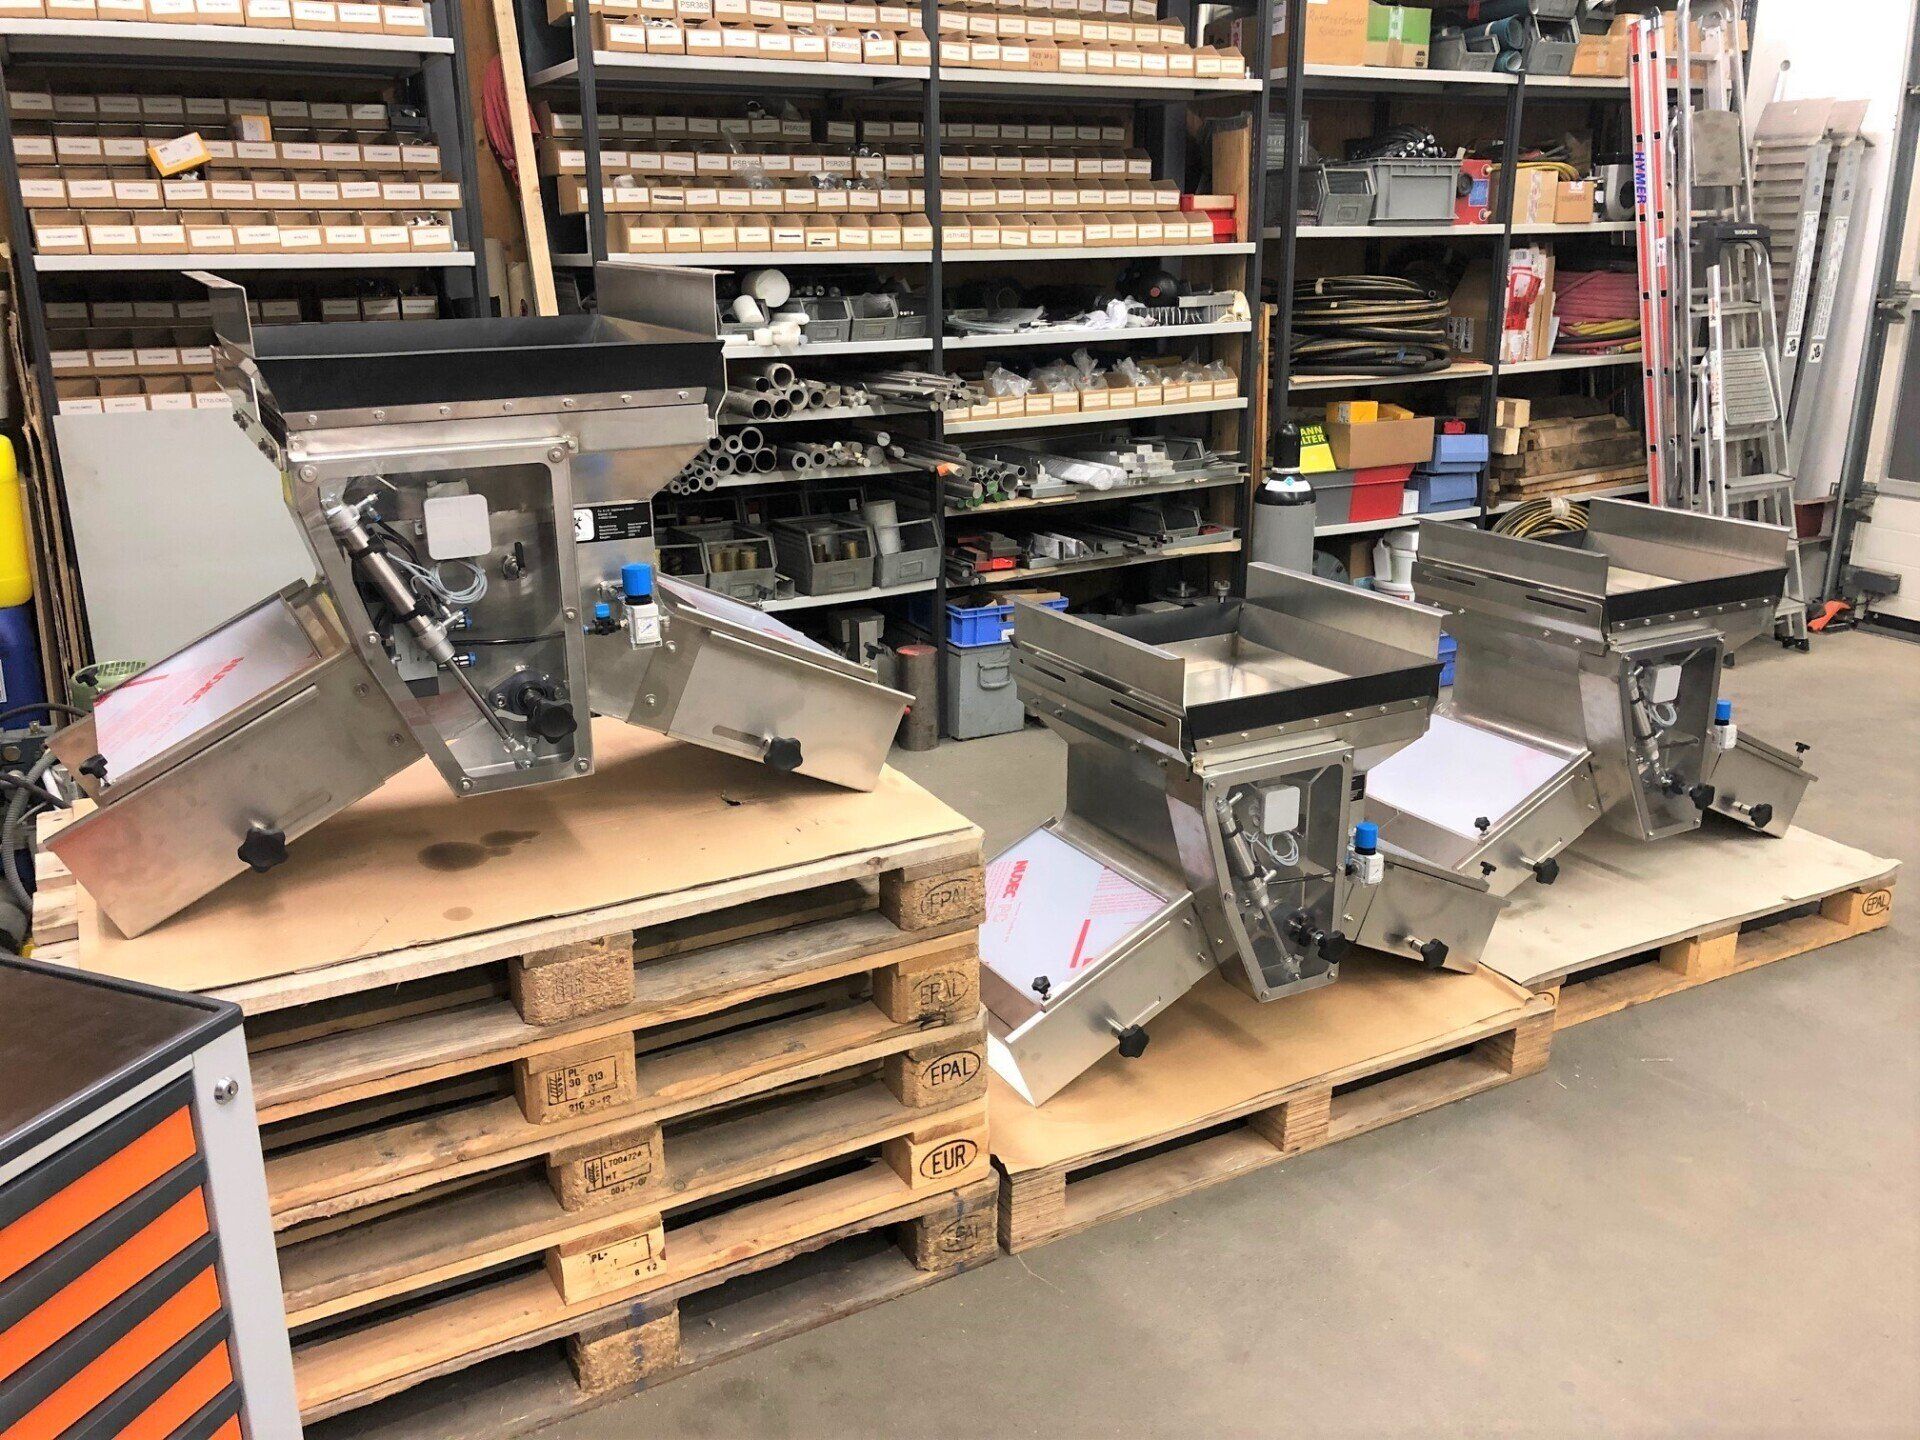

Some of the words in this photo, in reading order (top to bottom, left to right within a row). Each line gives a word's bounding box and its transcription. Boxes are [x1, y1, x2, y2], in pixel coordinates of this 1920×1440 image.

[1635, 152, 1647, 204] HYMER
[1300, 426, 1323, 437] ANN
[1002, 860, 1029, 899] NUDEC
[1866, 894, 1887, 912] EPAL
[568, 1078, 581, 1088] 30
[930, 1057, 972, 1087] EPAL
[932, 1144, 966, 1175] EUR
